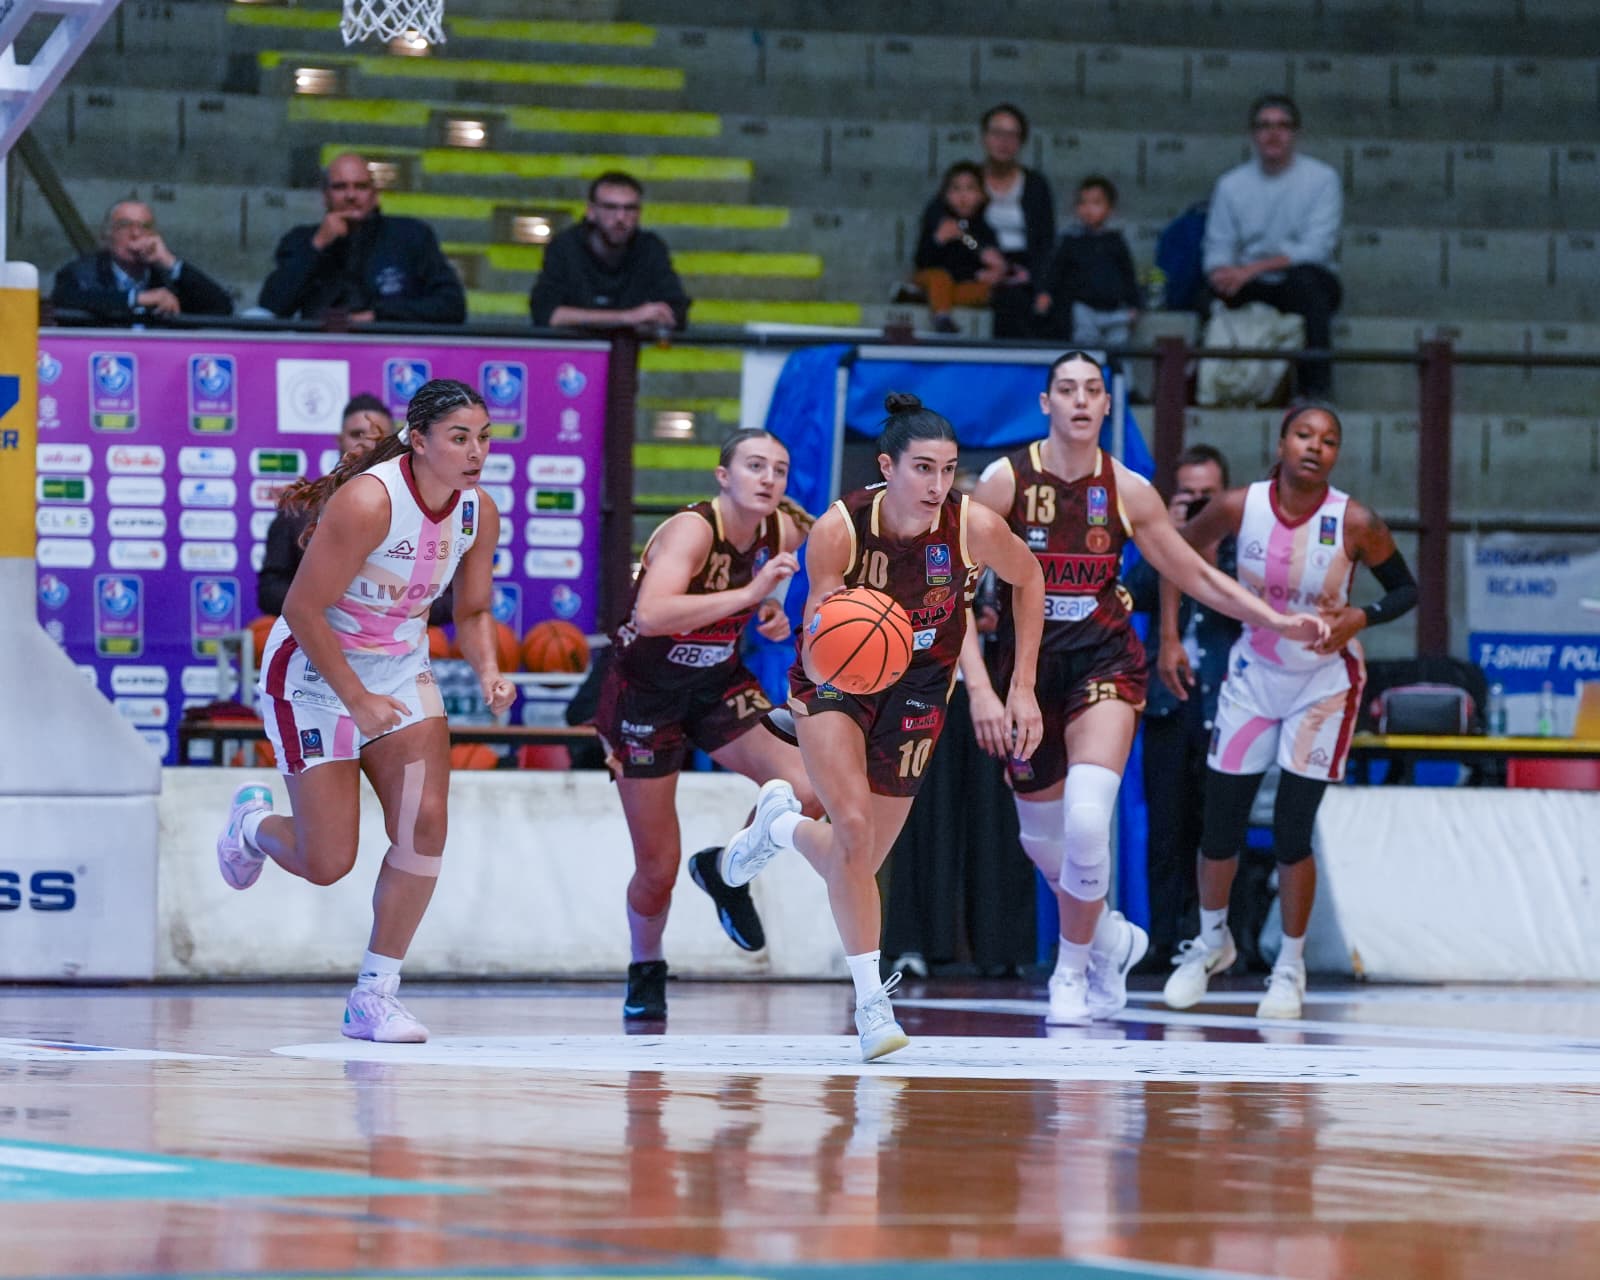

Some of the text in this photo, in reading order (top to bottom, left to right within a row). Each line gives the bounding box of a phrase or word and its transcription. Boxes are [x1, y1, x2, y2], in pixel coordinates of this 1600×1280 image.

[0, 429, 19, 449] R
[1024, 484, 1056, 524] 13
[423, 541, 449, 560] 33
[704, 552, 731, 590] 23
[857, 549, 889, 589] 10
[1043, 560, 1108, 585] MANA
[360, 582, 445, 601] LIVOR
[911, 606, 947, 626] NA
[1480, 643, 1554, 670] T-SHIRT
[726, 688, 773, 719] 23
[899, 738, 932, 777] 10
